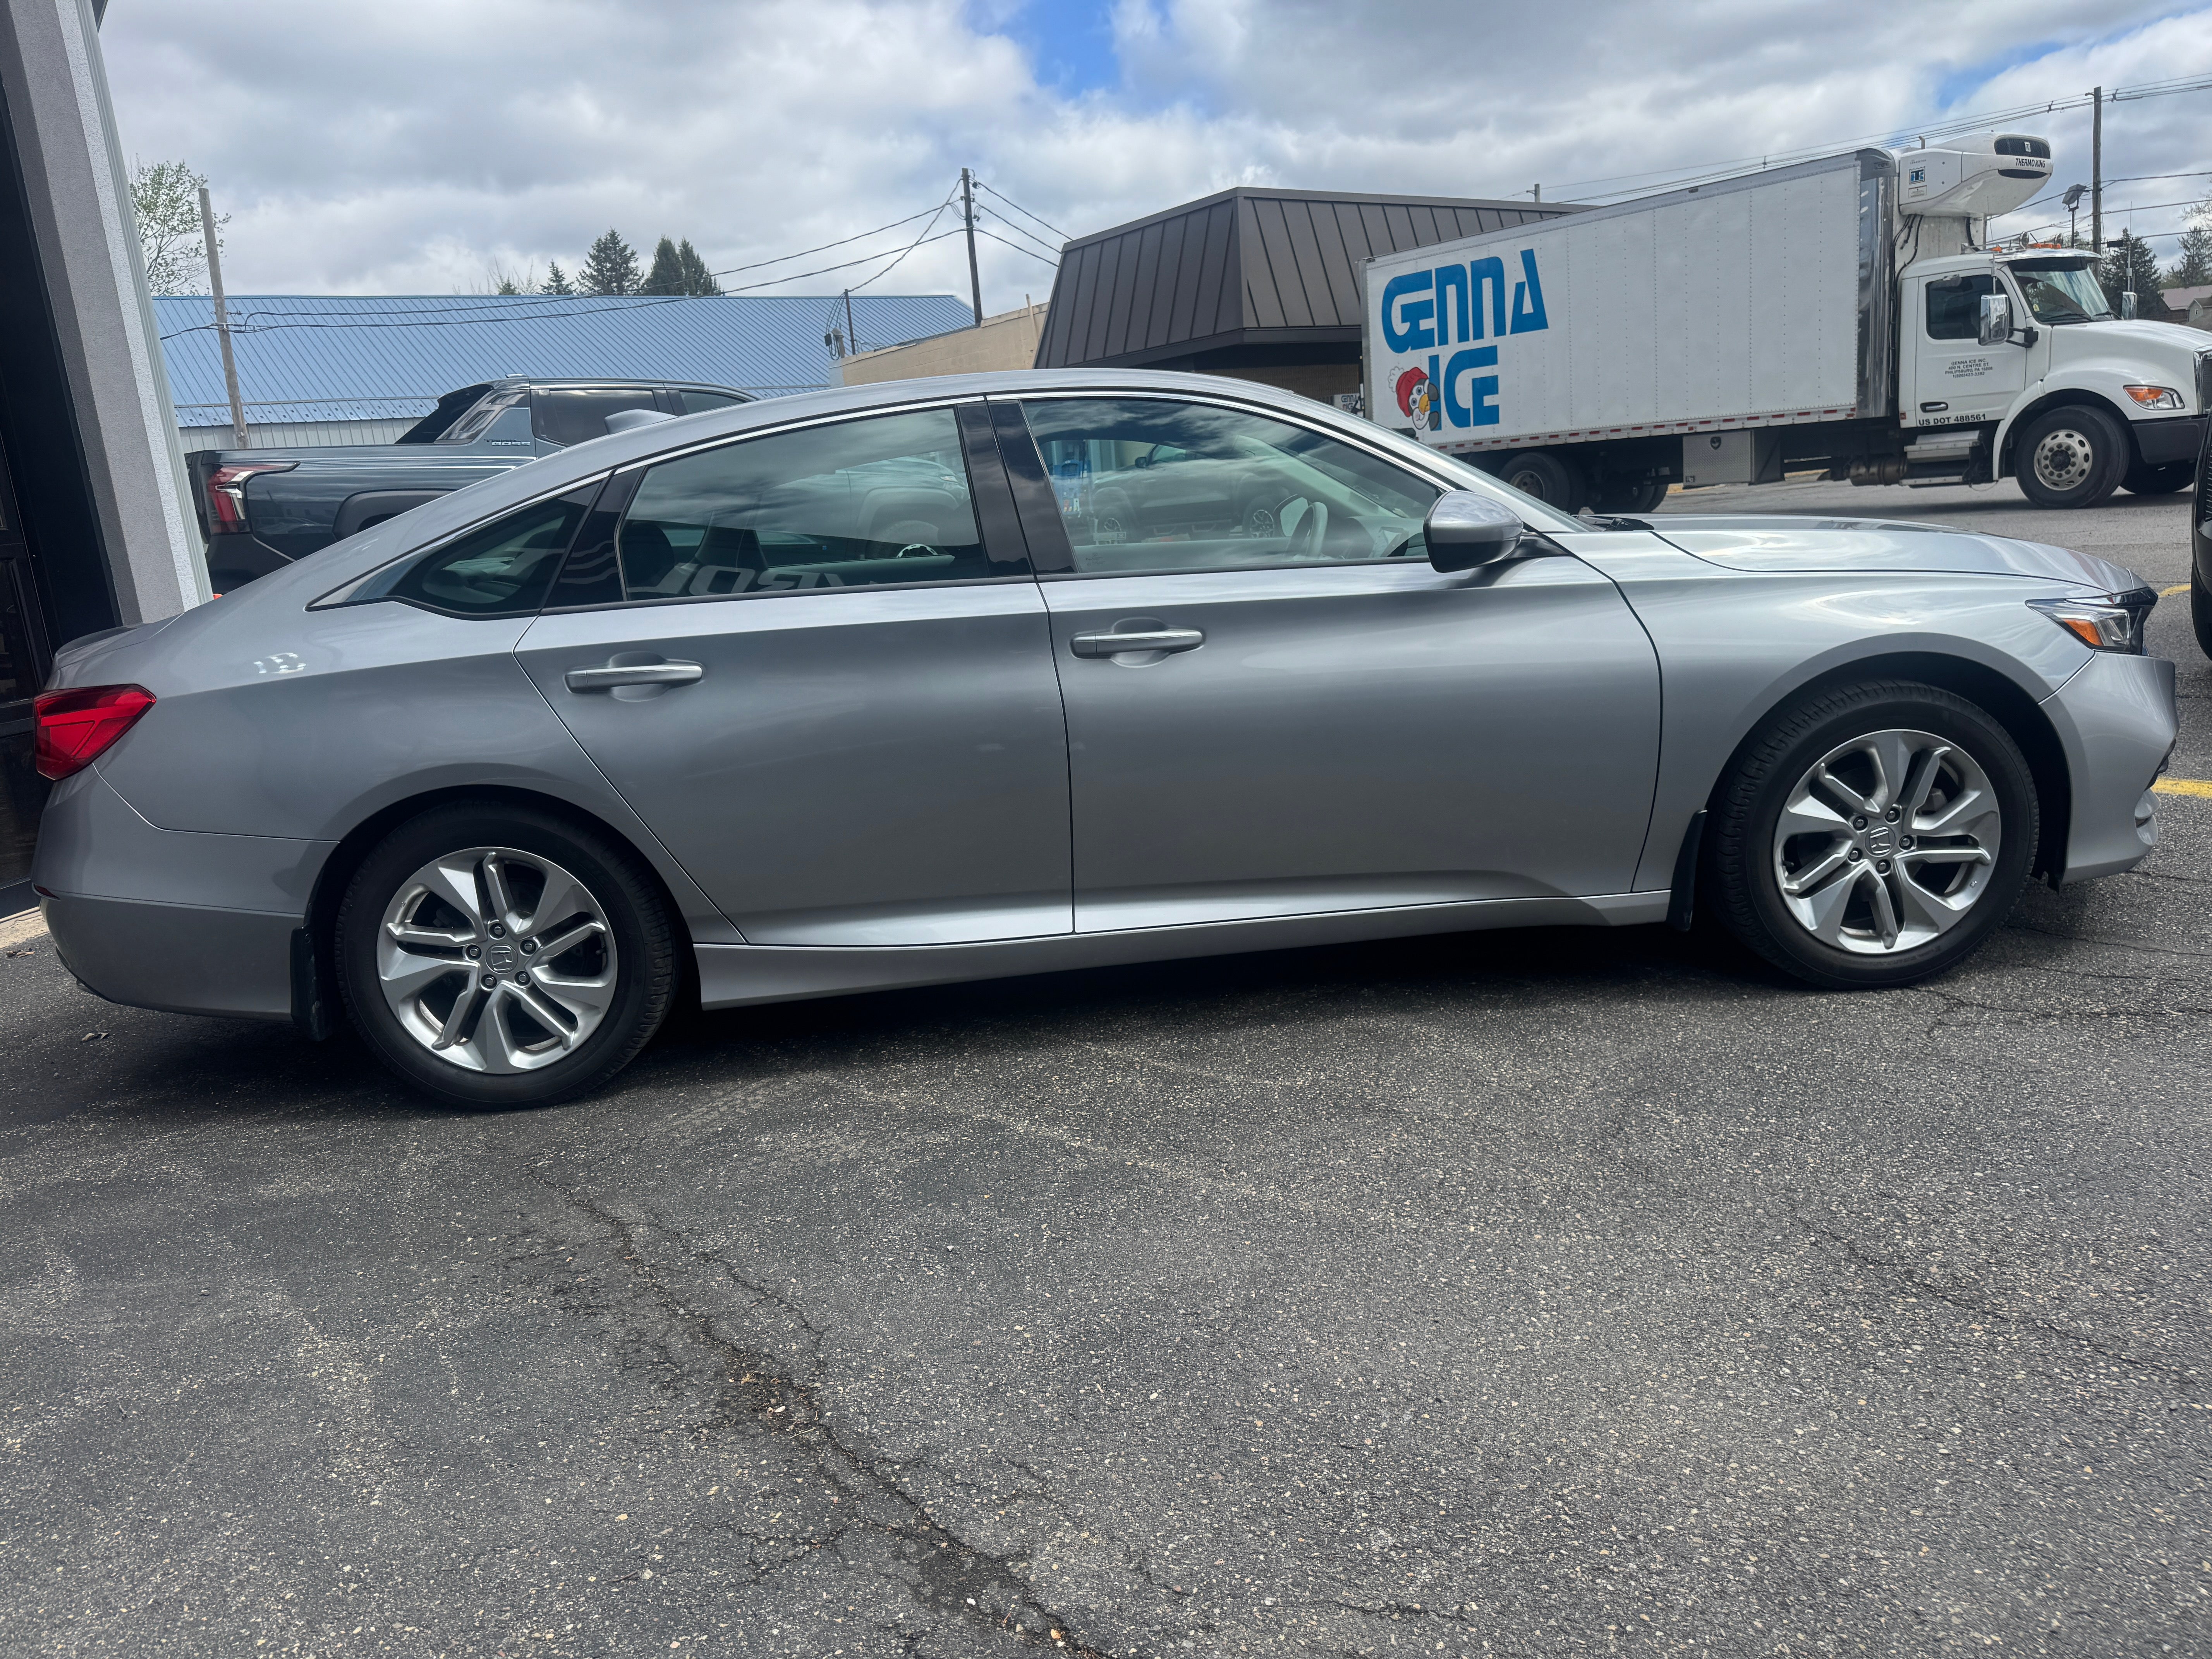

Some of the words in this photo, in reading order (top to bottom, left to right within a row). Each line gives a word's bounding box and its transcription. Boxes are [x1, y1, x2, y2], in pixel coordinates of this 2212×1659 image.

[2016, 158, 2035, 167] THERMO
[1381, 249, 1549, 354] GENNA
[1428, 345, 1499, 431] ICE
[1954, 413, 1986, 422] 488561
